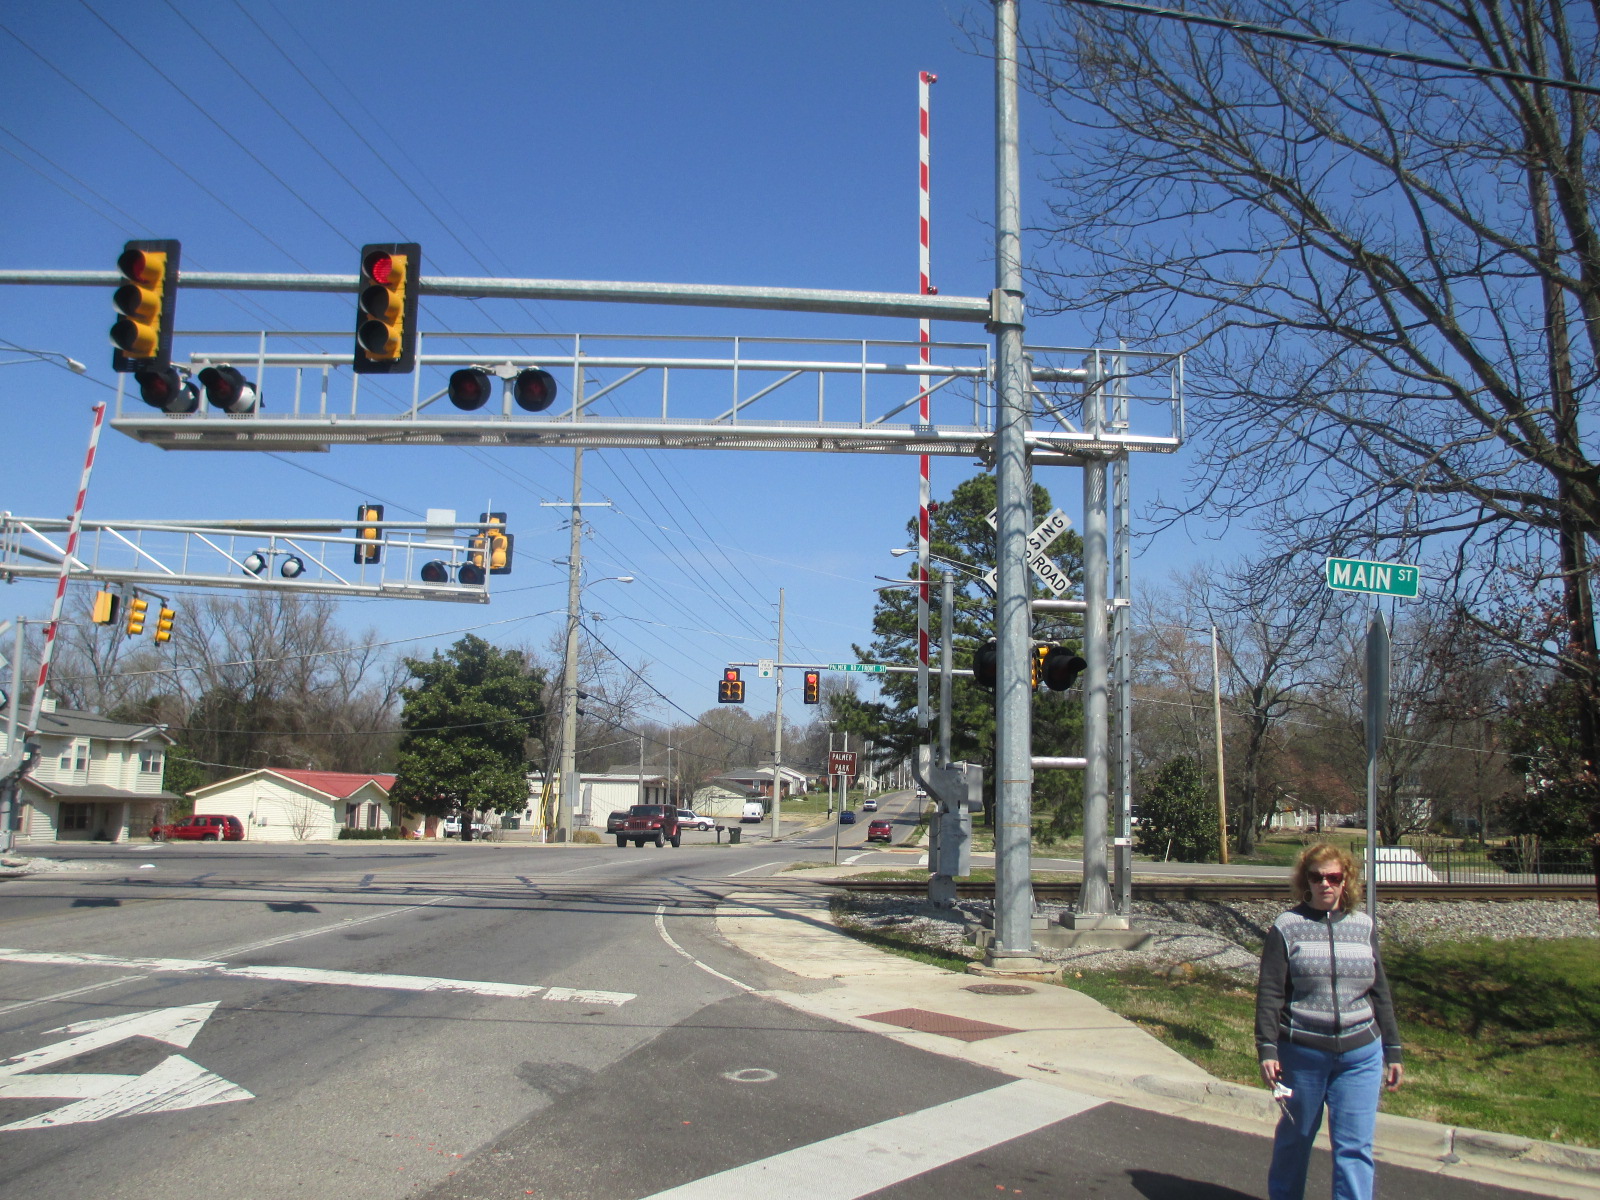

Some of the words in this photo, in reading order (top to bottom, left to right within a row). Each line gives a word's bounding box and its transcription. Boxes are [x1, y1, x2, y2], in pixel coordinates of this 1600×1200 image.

[1032, 556, 1066, 591] ROAD
[1333, 563, 1392, 590] MAIN
[1398, 569, 1413, 582] ST
[832, 753, 852, 761] PALMER
[835, 764, 850, 772] PARK
